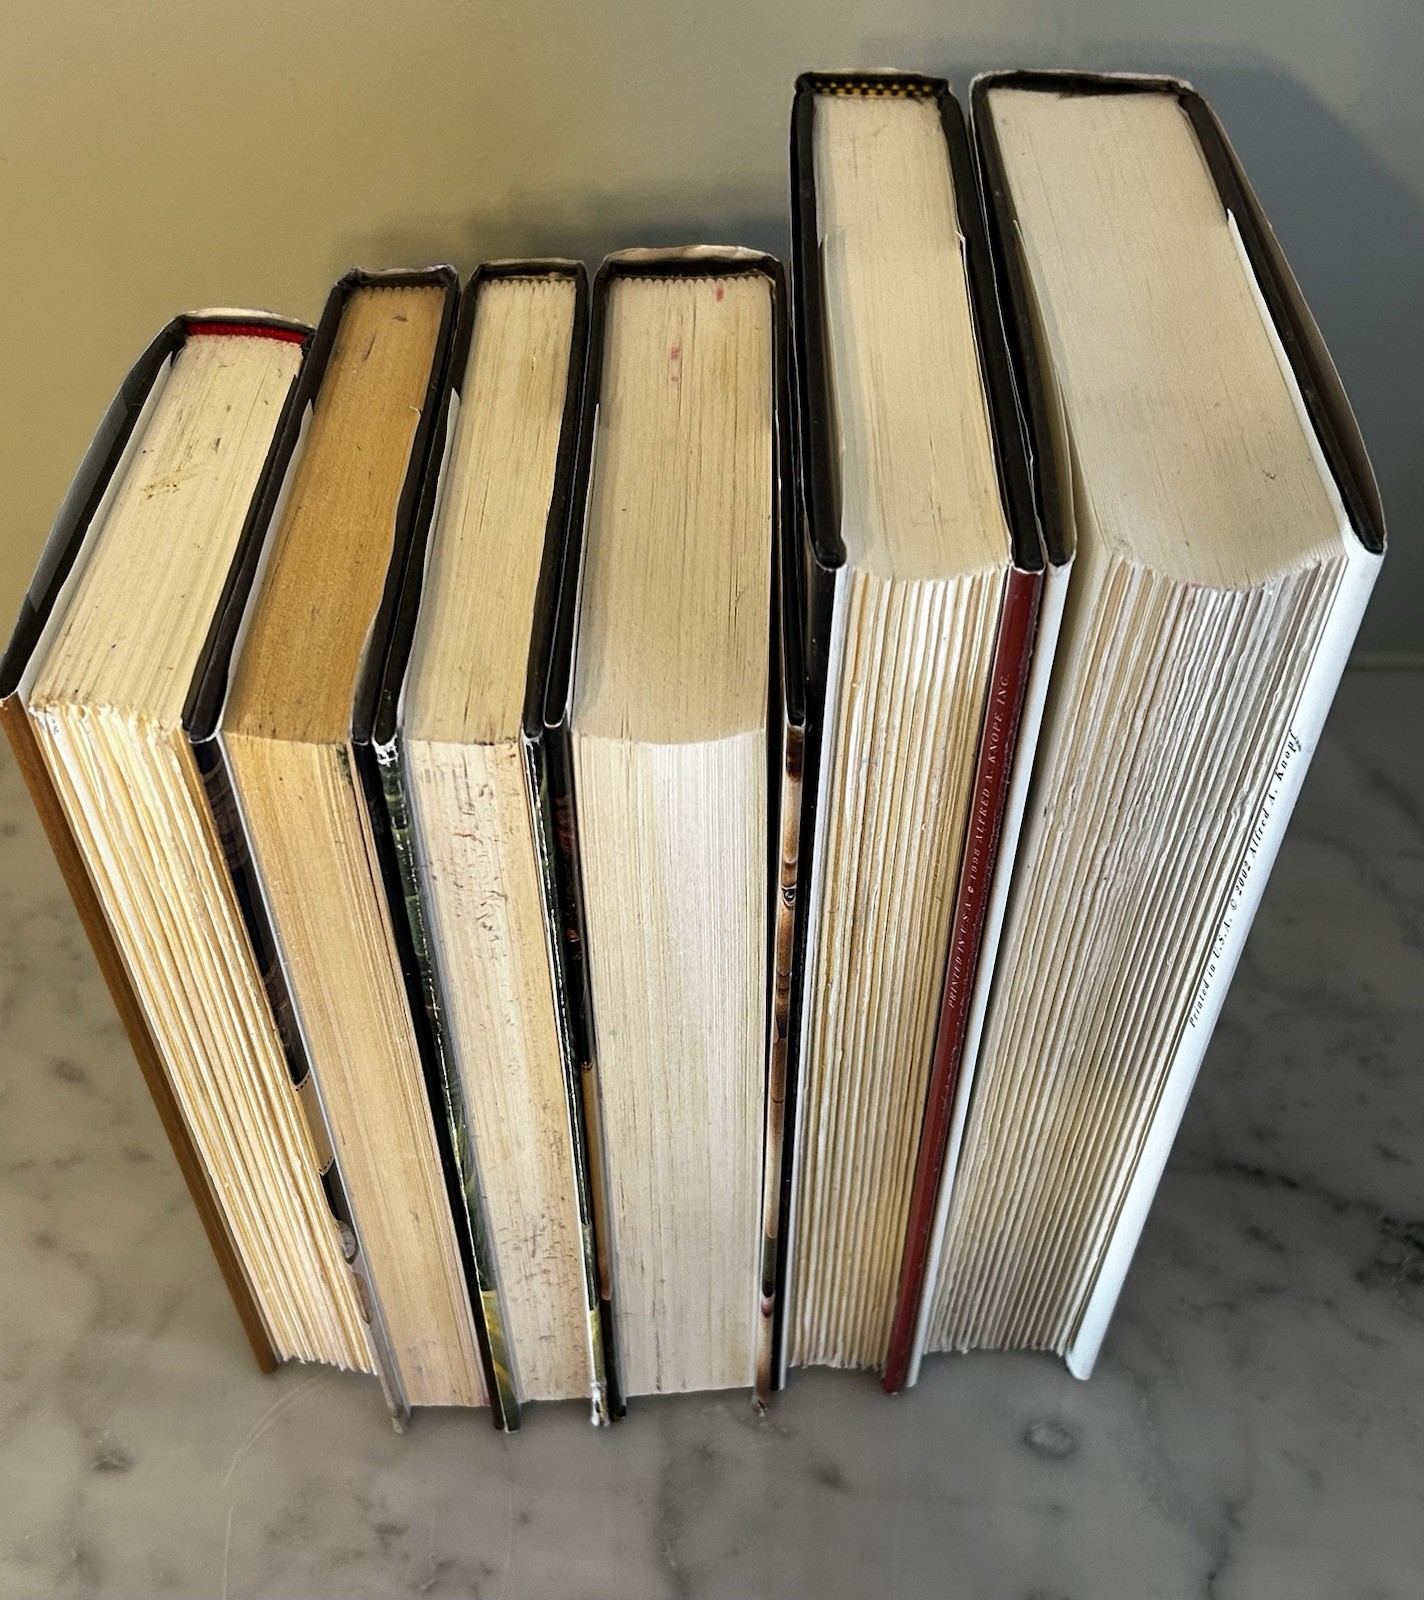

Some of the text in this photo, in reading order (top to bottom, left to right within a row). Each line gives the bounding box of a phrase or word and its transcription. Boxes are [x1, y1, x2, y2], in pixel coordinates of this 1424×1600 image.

[949, 956, 962, 1008] PRINTED
[957, 939, 966, 956] IN
[975, 788, 990, 844] ALFRED
[1189, 978, 1211, 1028] Printed
[1207, 963, 1217, 977] in
[1213, 918, 1234, 959] U.S.A.
[1235, 860, 1252, 895] 2002
[1250, 808, 1271, 858] Alfred
[1267, 789, 1279, 805] A.
[1274, 728, 1300, 782] Knopf
